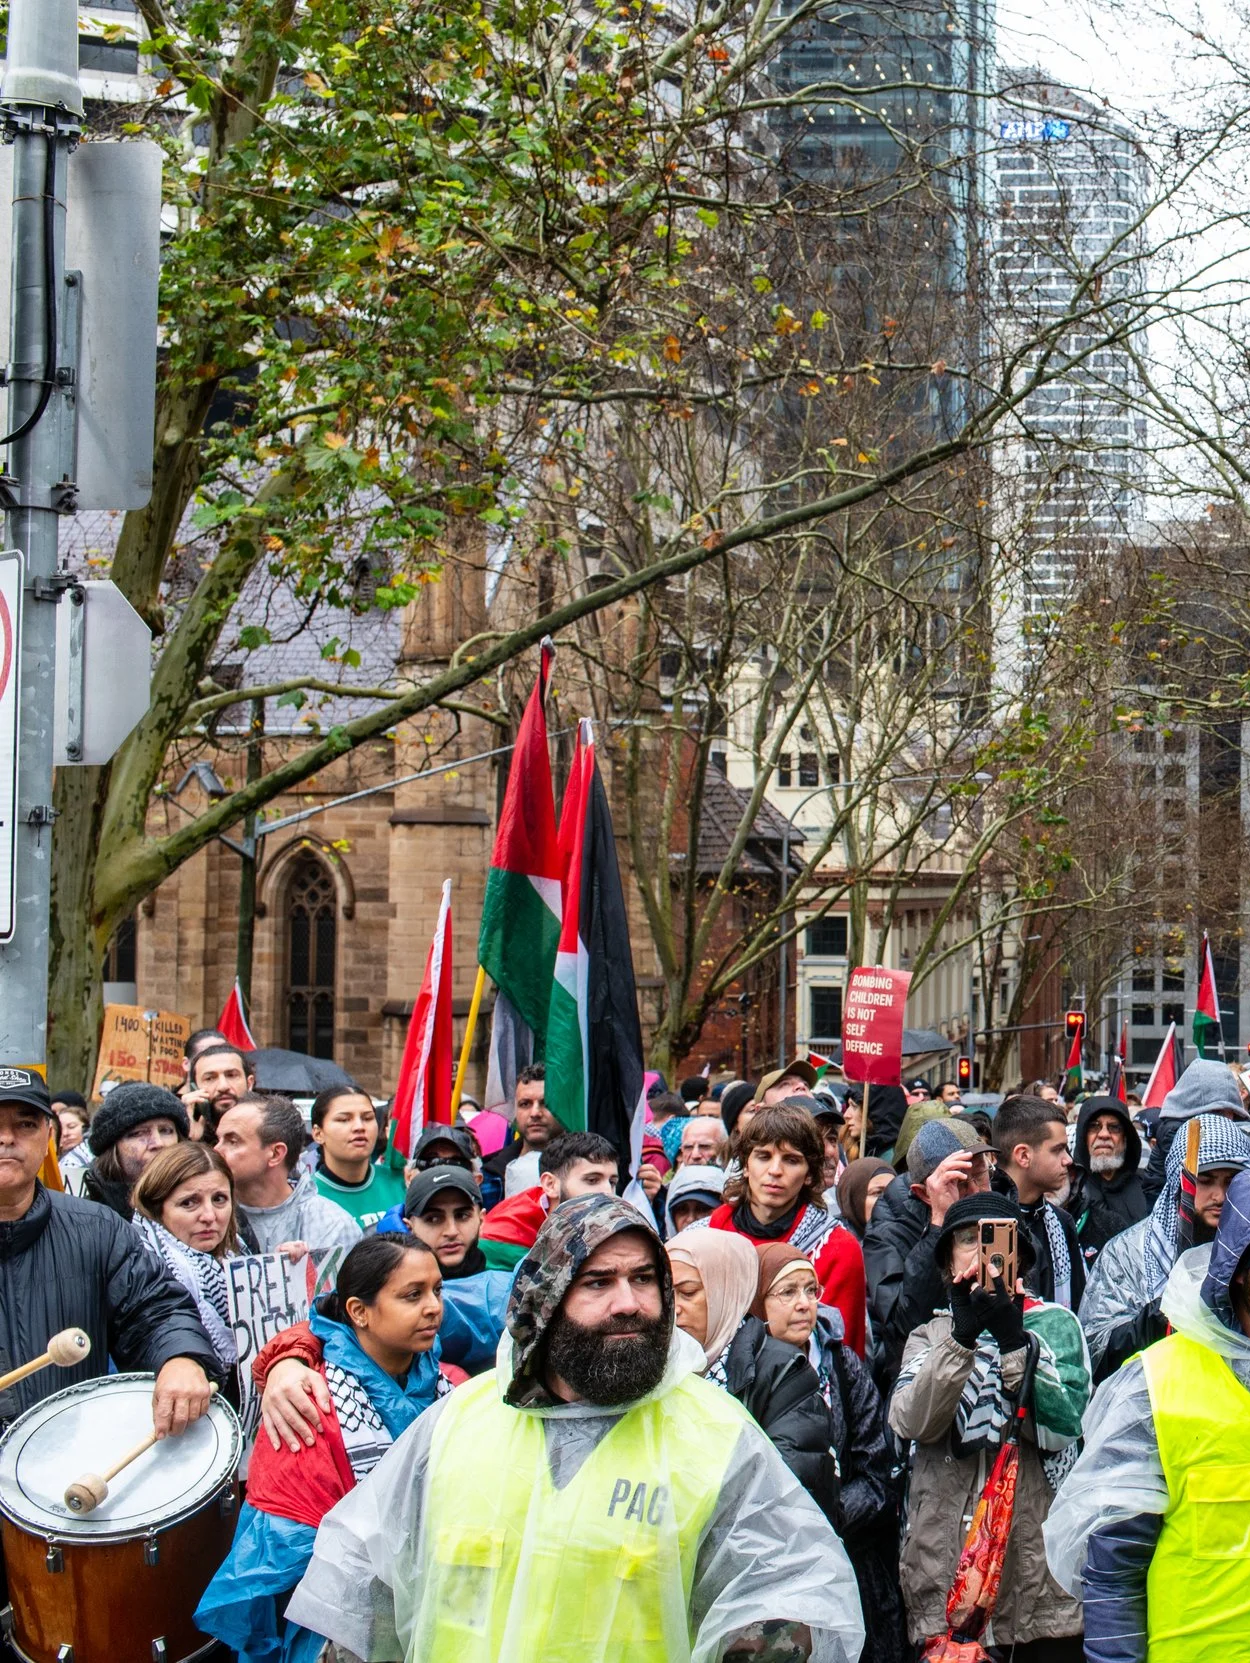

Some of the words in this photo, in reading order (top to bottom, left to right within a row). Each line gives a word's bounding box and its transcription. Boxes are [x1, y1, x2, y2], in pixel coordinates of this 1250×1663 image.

[852, 974, 893, 990] BOMBING
[849, 990, 893, 1007] CHILDREN
[847, 1006, 856, 1019] IS
[857, 1008, 876, 1022] NOT
[845, 1022, 866, 1037] SELF
[160, 1046, 179, 1059] FOOD
[845, 1038, 883, 1056] DEFENCE
[230, 1253, 291, 1322] FREE
[607, 1478, 669, 1527] PAG
